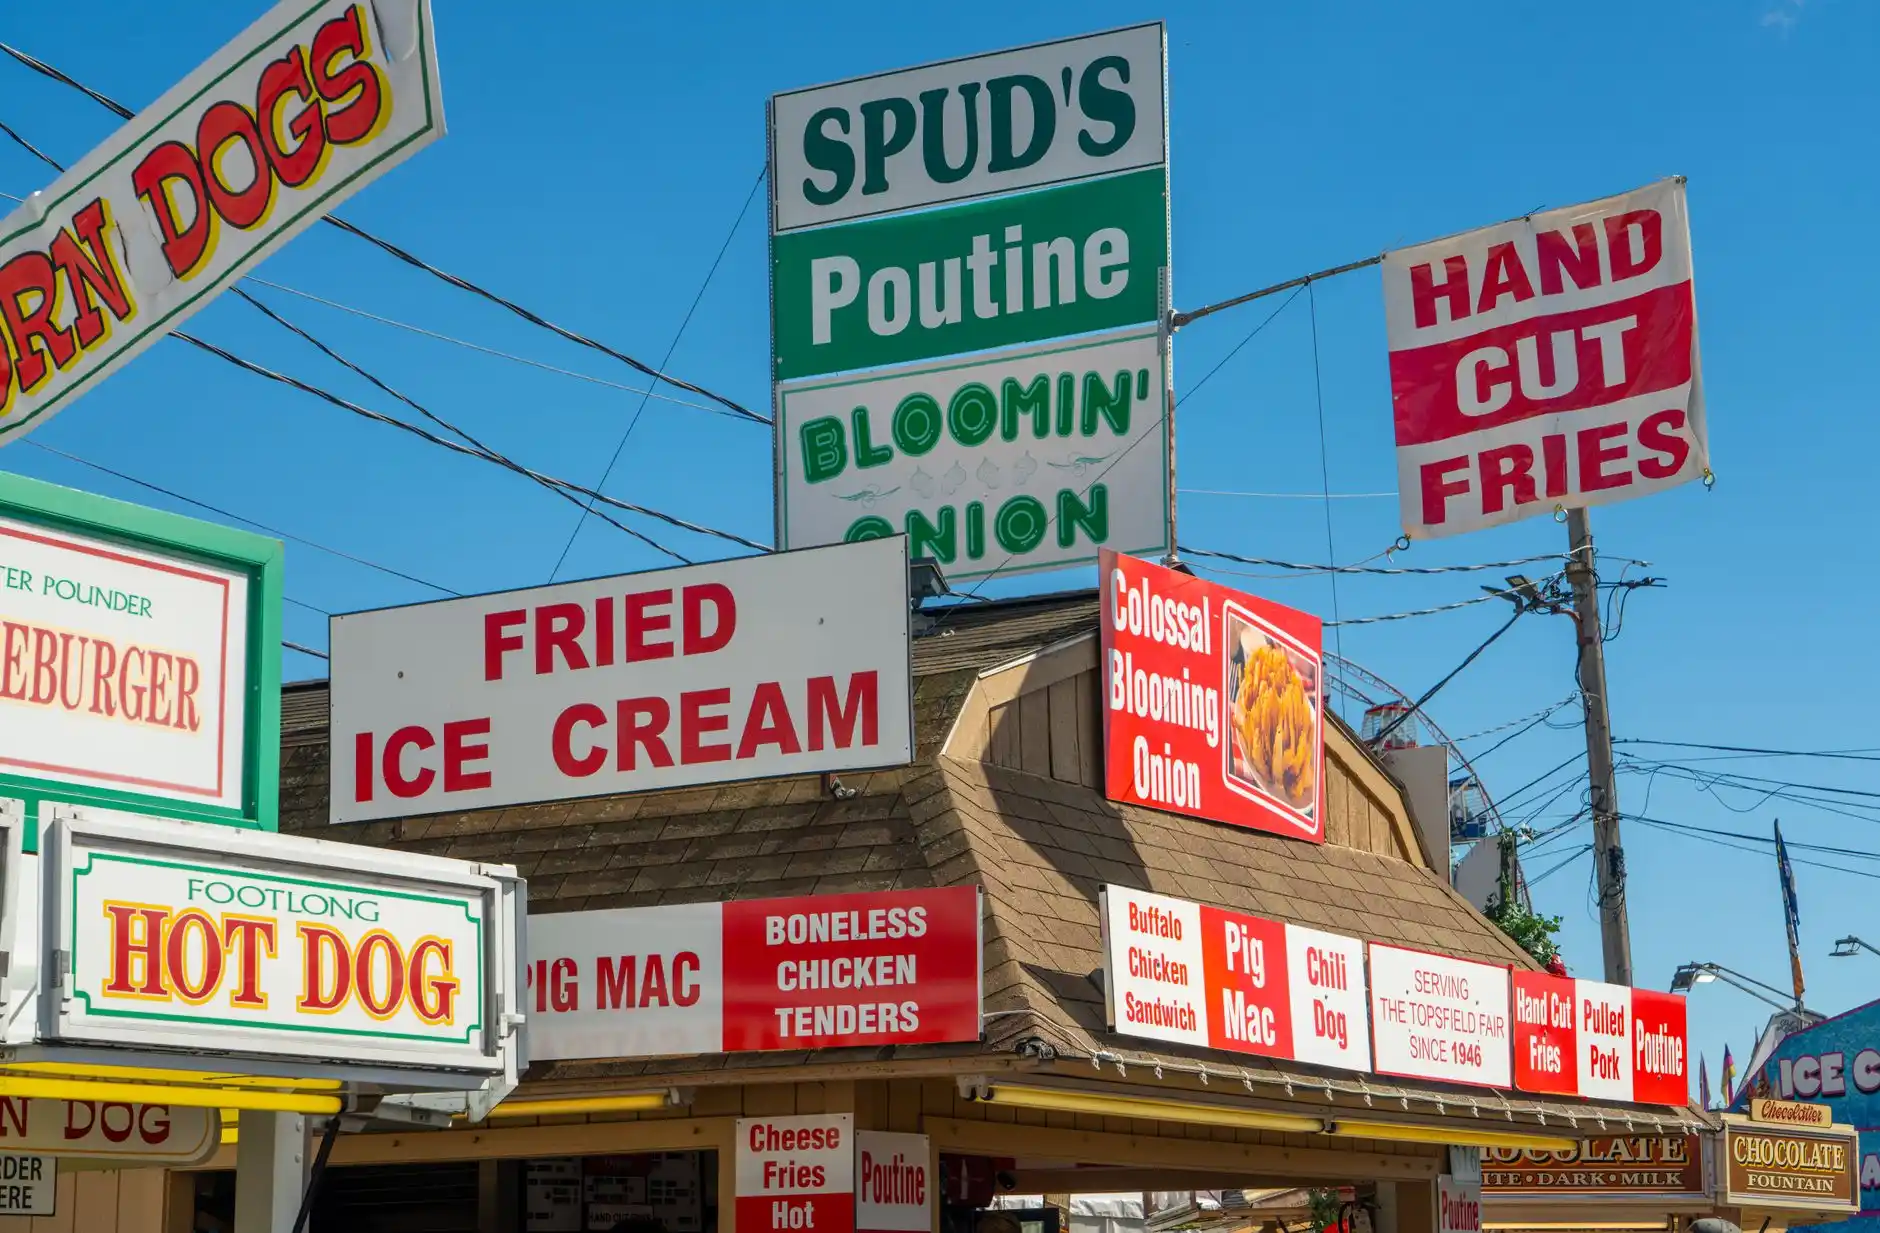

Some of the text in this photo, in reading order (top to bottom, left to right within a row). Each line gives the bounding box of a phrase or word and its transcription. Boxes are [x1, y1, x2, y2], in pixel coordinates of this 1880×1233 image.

[803, 55, 1136, 205] SPUD'S
[0, 3, 391, 414] RN DOGS
[811, 224, 1130, 345] Poutine
[1410, 209, 1662, 328] HAND
[1455, 314, 1637, 418] CUT
[800, 368, 1149, 484] BLOOMIN'
[1420, 409, 1690, 525] FRIES
[43, 575, 152, 623] POUNDER
[1111, 568, 1211, 655] Colossal
[484, 582, 736, 681] FRIED
[1108, 648, 1219, 748] Blooming
[355, 670, 878, 802] ICE CREAM
[1133, 735, 1201, 809] Onion
[188, 879, 380, 922] FOOTLONG
[1129, 901, 1182, 941] Buffalo
[765, 907, 927, 946] BONELESS
[104, 901, 459, 1025] HOT DOG
[777, 954, 916, 992] CHICKEN
[1128, 946, 1188, 986] Chicken
[1224, 920, 1265, 988] Pig
[1307, 946, 1347, 991] Chili
[597, 951, 700, 1010] MAC
[1414, 969, 1469, 1001] SERVING
[775, 1001, 919, 1038] TENDERS
[1126, 991, 1196, 1032] Sandwich
[1222, 988, 1276, 1047] Mac
[1313, 999, 1347, 1050] Dog
[1379, 997, 1505, 1038] THE TOPSFIELD FAIR
[1516, 987, 1572, 1028] Hand Cut
[1584, 999, 1625, 1037] Pulled
[1410, 1034, 1482, 1067] SINCE 1946
[1529, 1035, 1561, 1073] Fries
[1590, 1044, 1620, 1081] Pork
[1635, 1019, 1683, 1077] Poutine
[1780, 1052, 1845, 1098] ICE
[62, 1099, 170, 1144] DOG
[1761, 1099, 1823, 1122] Chocolatier
[750, 1124, 840, 1152] Cheese
[1734, 1136, 1845, 1172] CHOCOLATE
[0, 1157, 42, 1181] DER
[764, 1160, 825, 1189] Fries
[862, 1151, 925, 1206] Poutine
[1537, 1172, 1606, 1186] DARK
[1621, 1172, 1683, 1186] MILK
[1747, 1173, 1834, 1192] FOUNTAIN
[772, 1201, 815, 1229] Hot
[1441, 1190, 1479, 1231] Poutine
